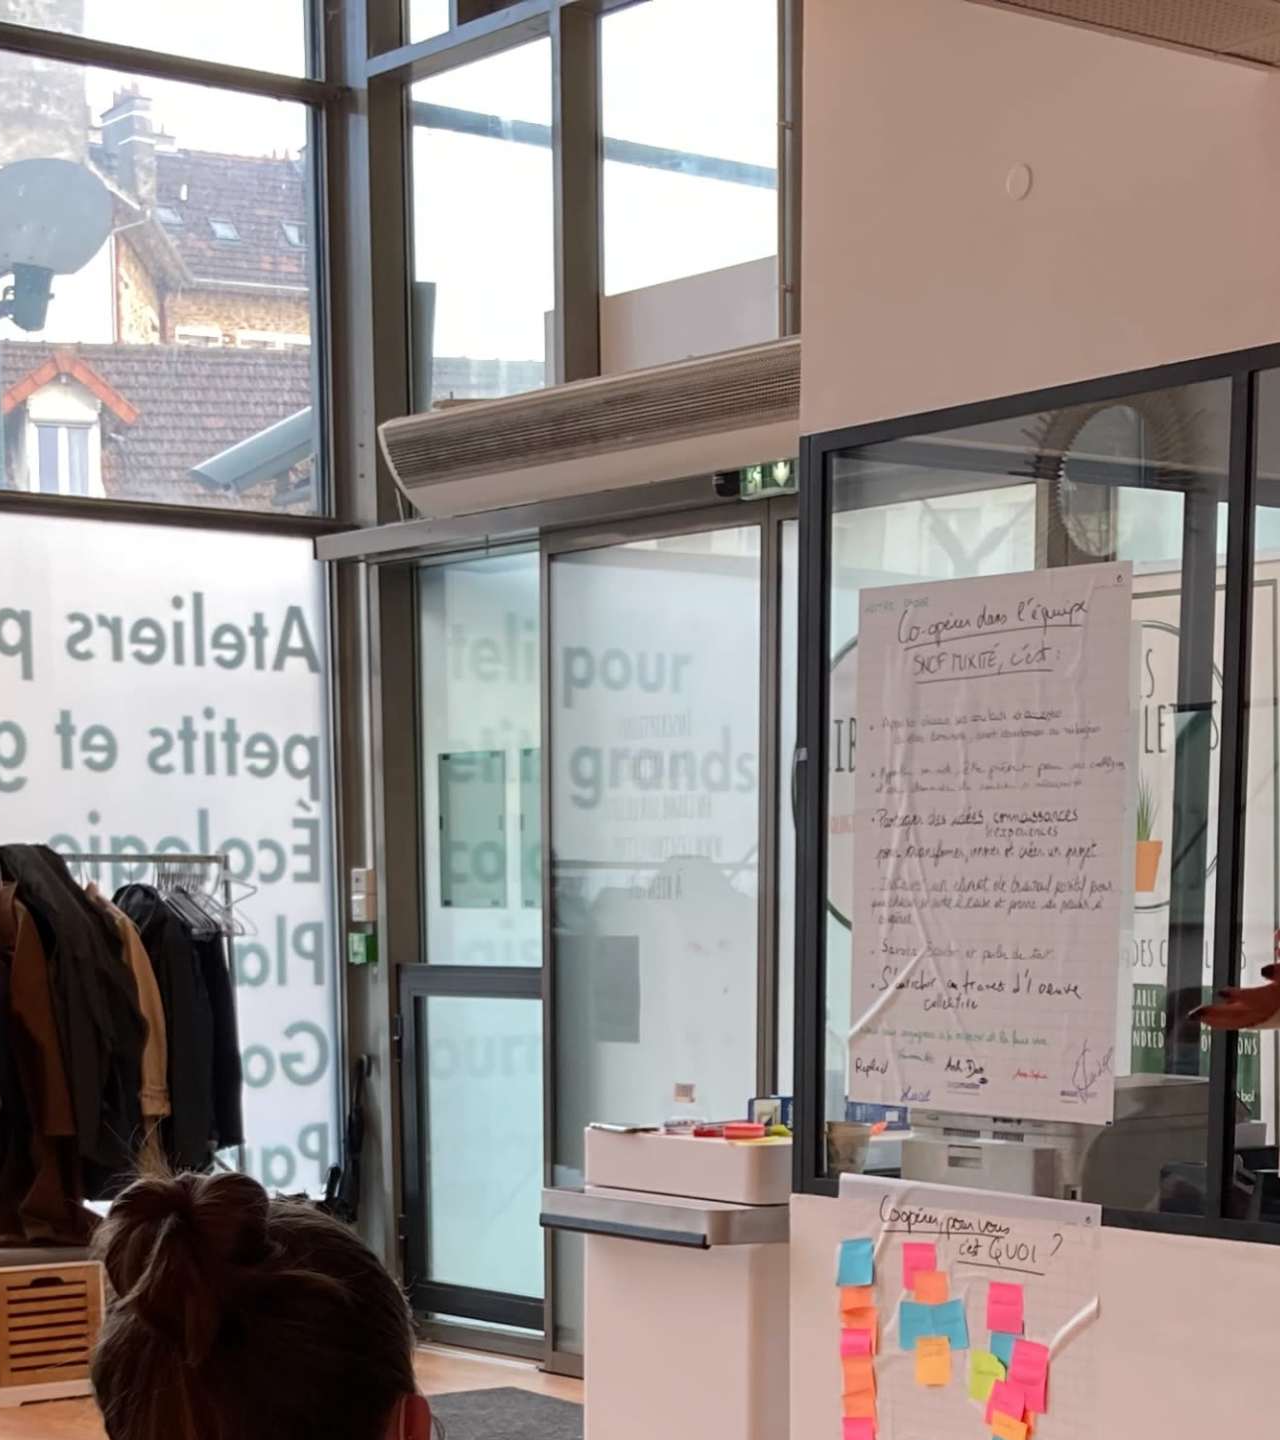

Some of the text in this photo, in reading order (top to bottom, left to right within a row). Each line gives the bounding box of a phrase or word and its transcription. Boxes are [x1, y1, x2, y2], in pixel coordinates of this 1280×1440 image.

[977, 604, 1007, 629] dans
[562, 645, 693, 710] pour
[569, 723, 756, 811] grands
[988, 1237, 1036, 1265] QUOI
